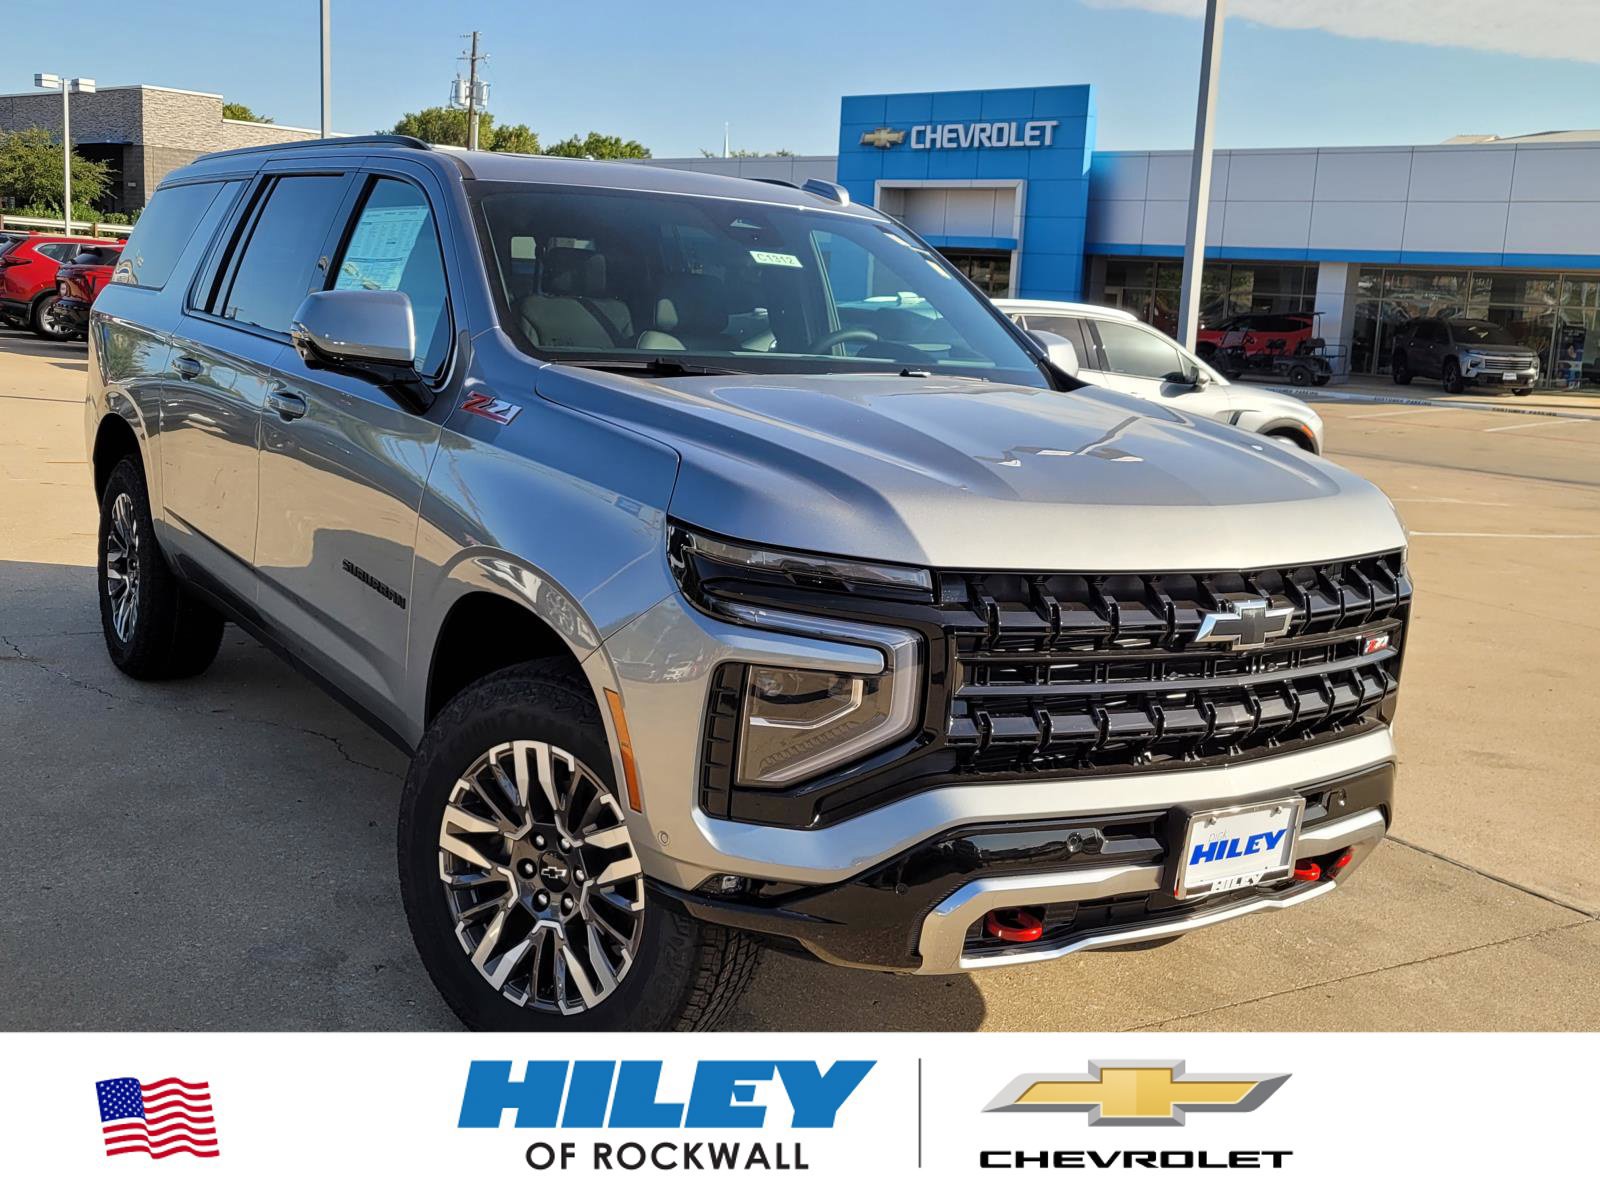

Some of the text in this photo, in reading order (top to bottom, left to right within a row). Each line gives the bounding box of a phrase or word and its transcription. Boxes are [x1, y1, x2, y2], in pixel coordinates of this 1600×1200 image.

[911, 120, 1059, 149] CHEVROLET
[342, 558, 406, 610] SUBURBAN
[1189, 828, 1288, 867] HILEY
